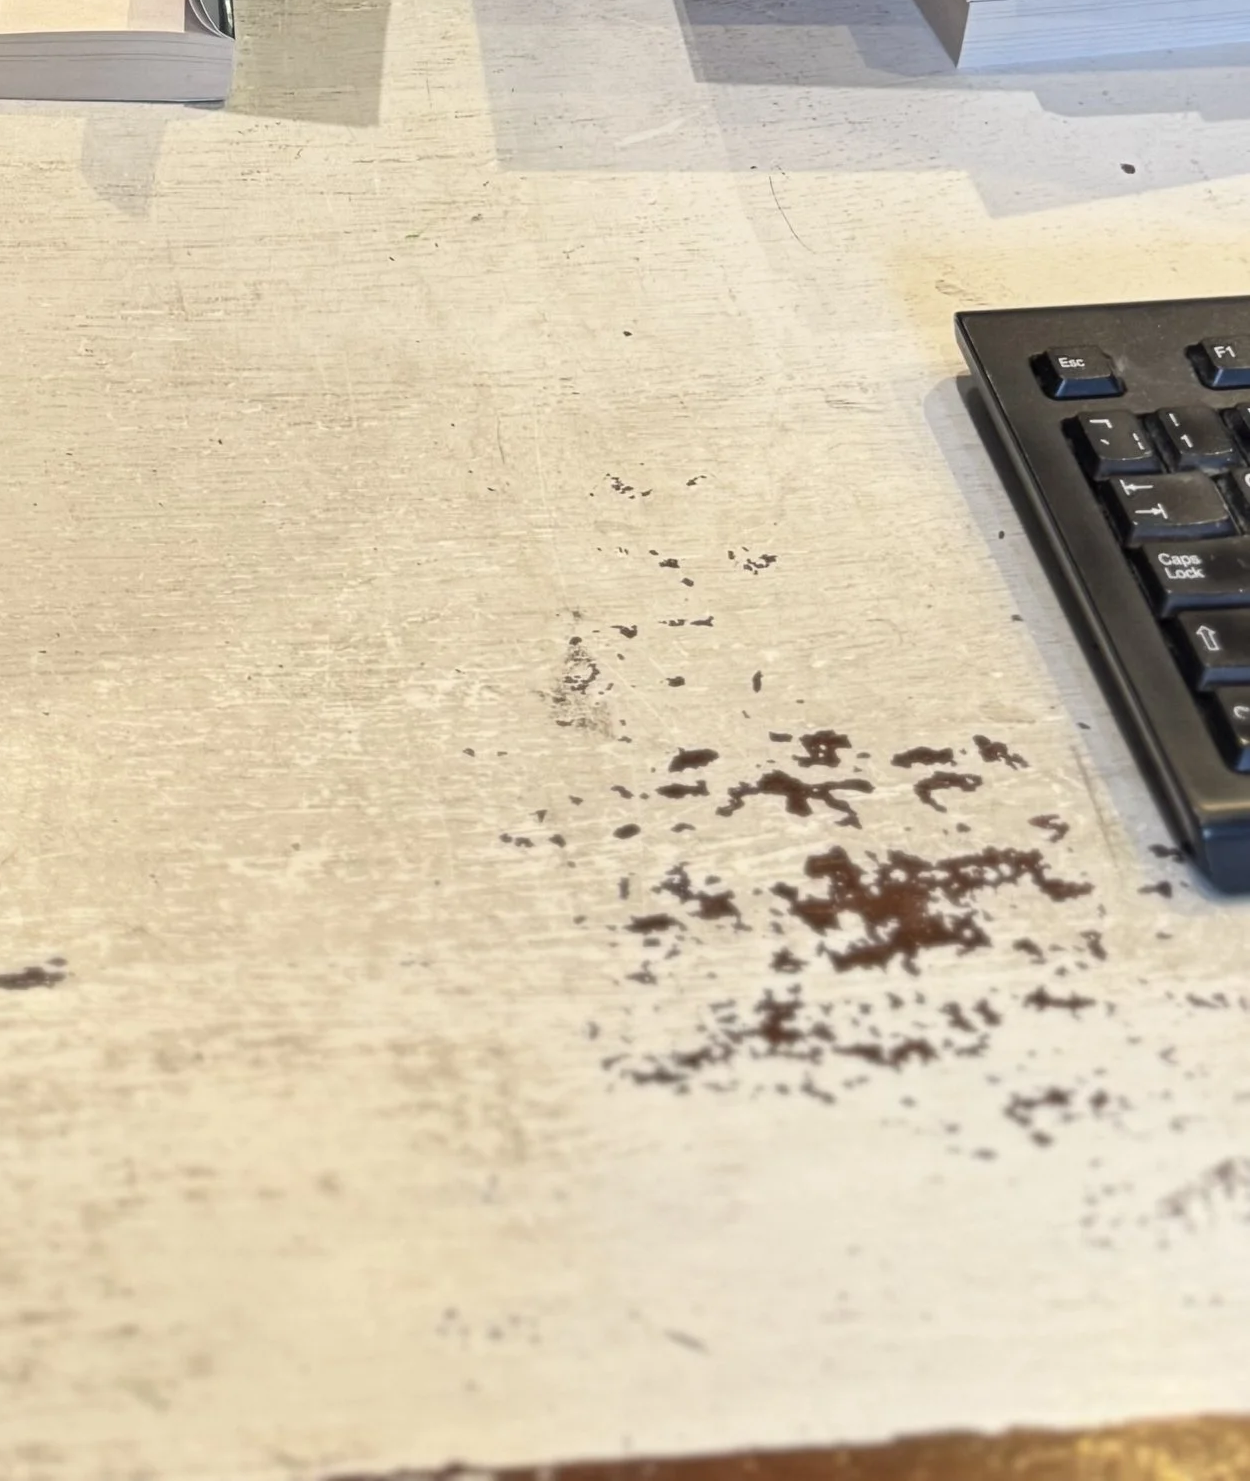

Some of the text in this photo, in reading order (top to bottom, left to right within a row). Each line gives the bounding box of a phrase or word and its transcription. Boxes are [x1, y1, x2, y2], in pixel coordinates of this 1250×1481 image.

[1213, 345, 1238, 359] F1
[1058, 356, 1086, 369] Esc
[1158, 552, 1203, 568] Caps
[1164, 566, 1206, 580] Lock
